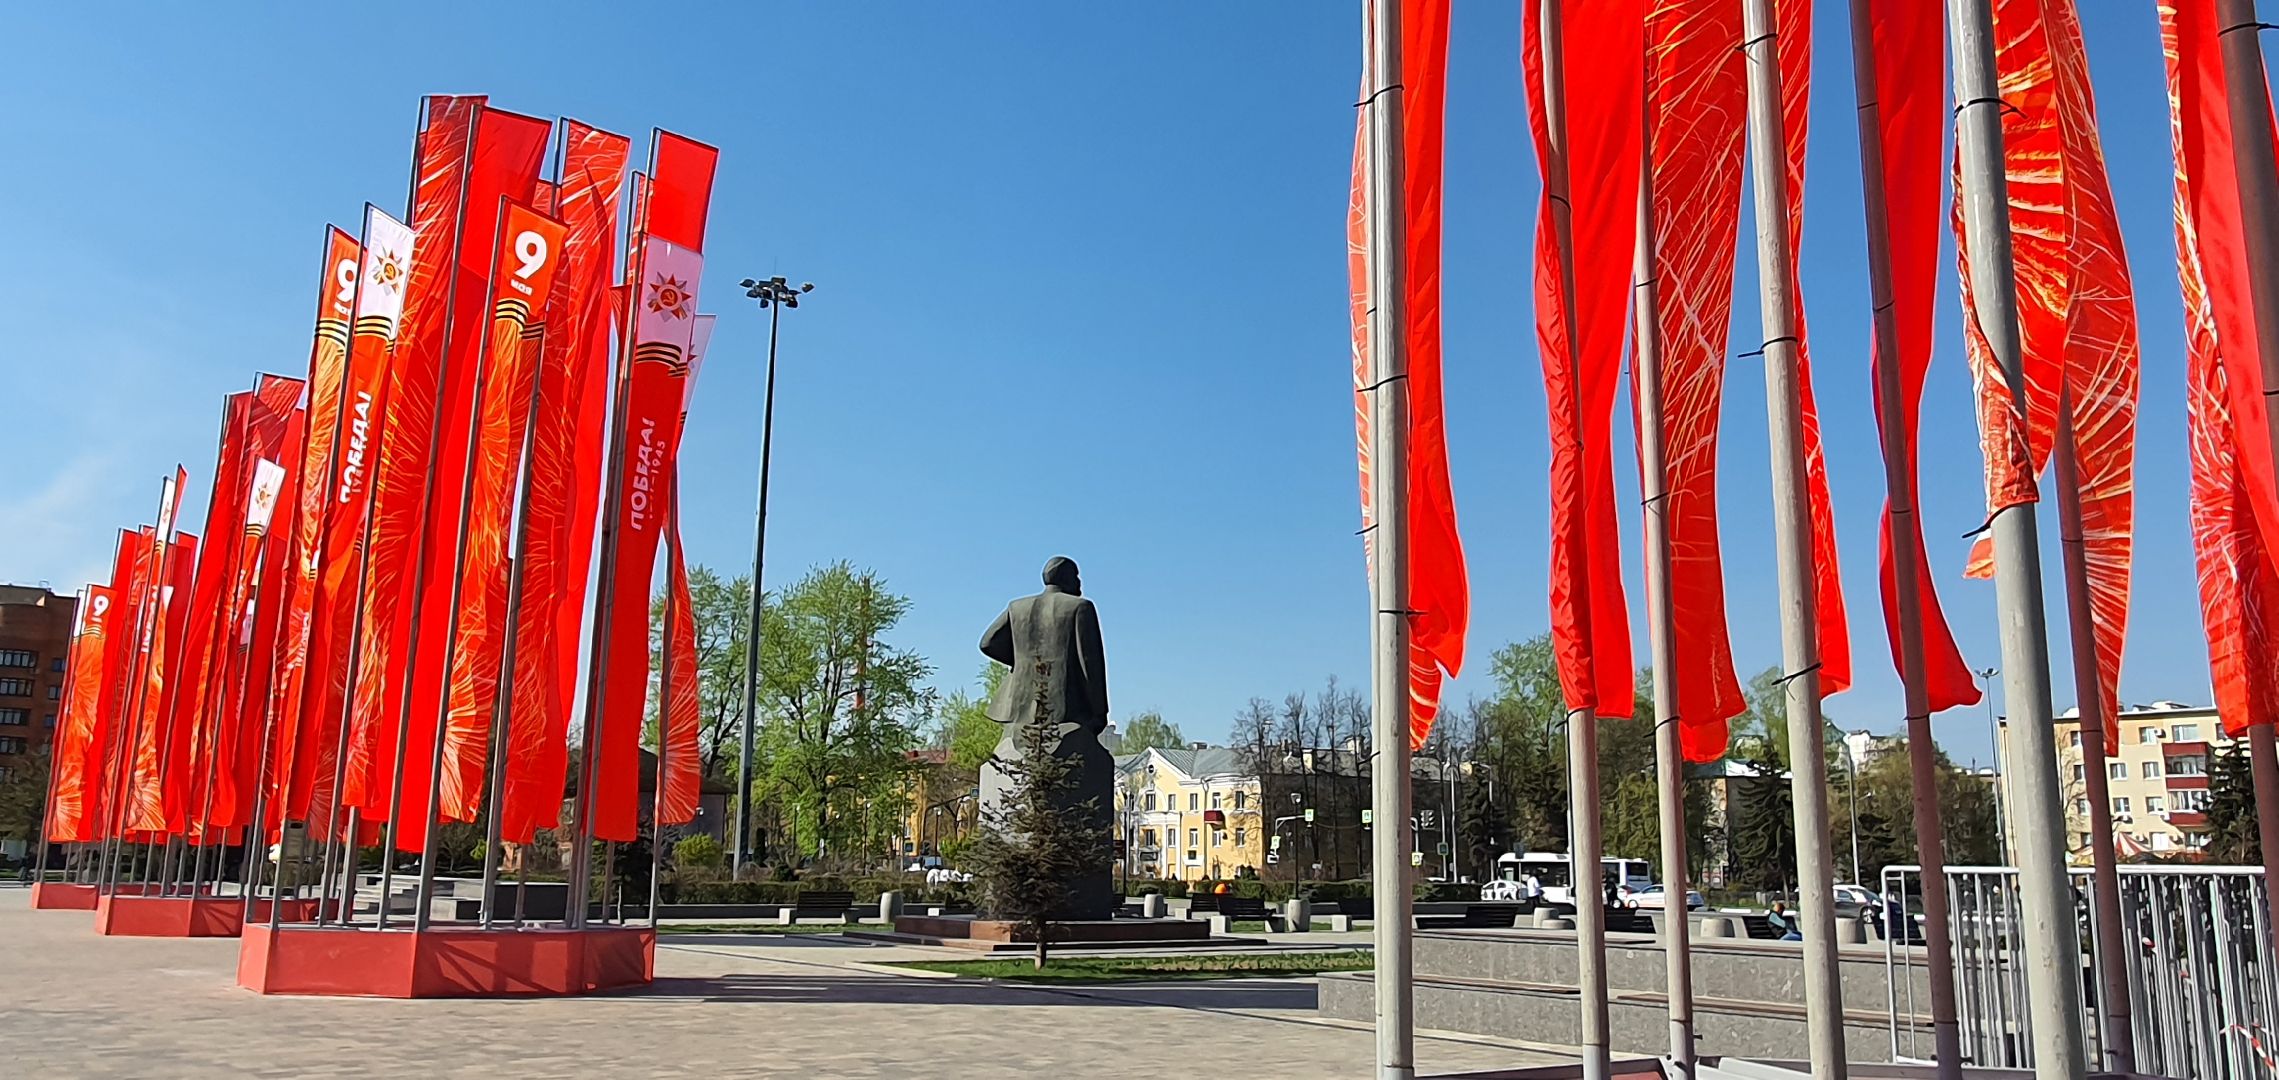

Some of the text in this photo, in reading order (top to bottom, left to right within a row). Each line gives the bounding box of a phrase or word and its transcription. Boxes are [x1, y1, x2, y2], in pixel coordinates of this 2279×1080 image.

[515, 230, 547, 280] 9
[337, 258, 359, 303] 9
[631, 417, 656, 531] ПОБЕДА!
[94, 595, 109, 616] 9
